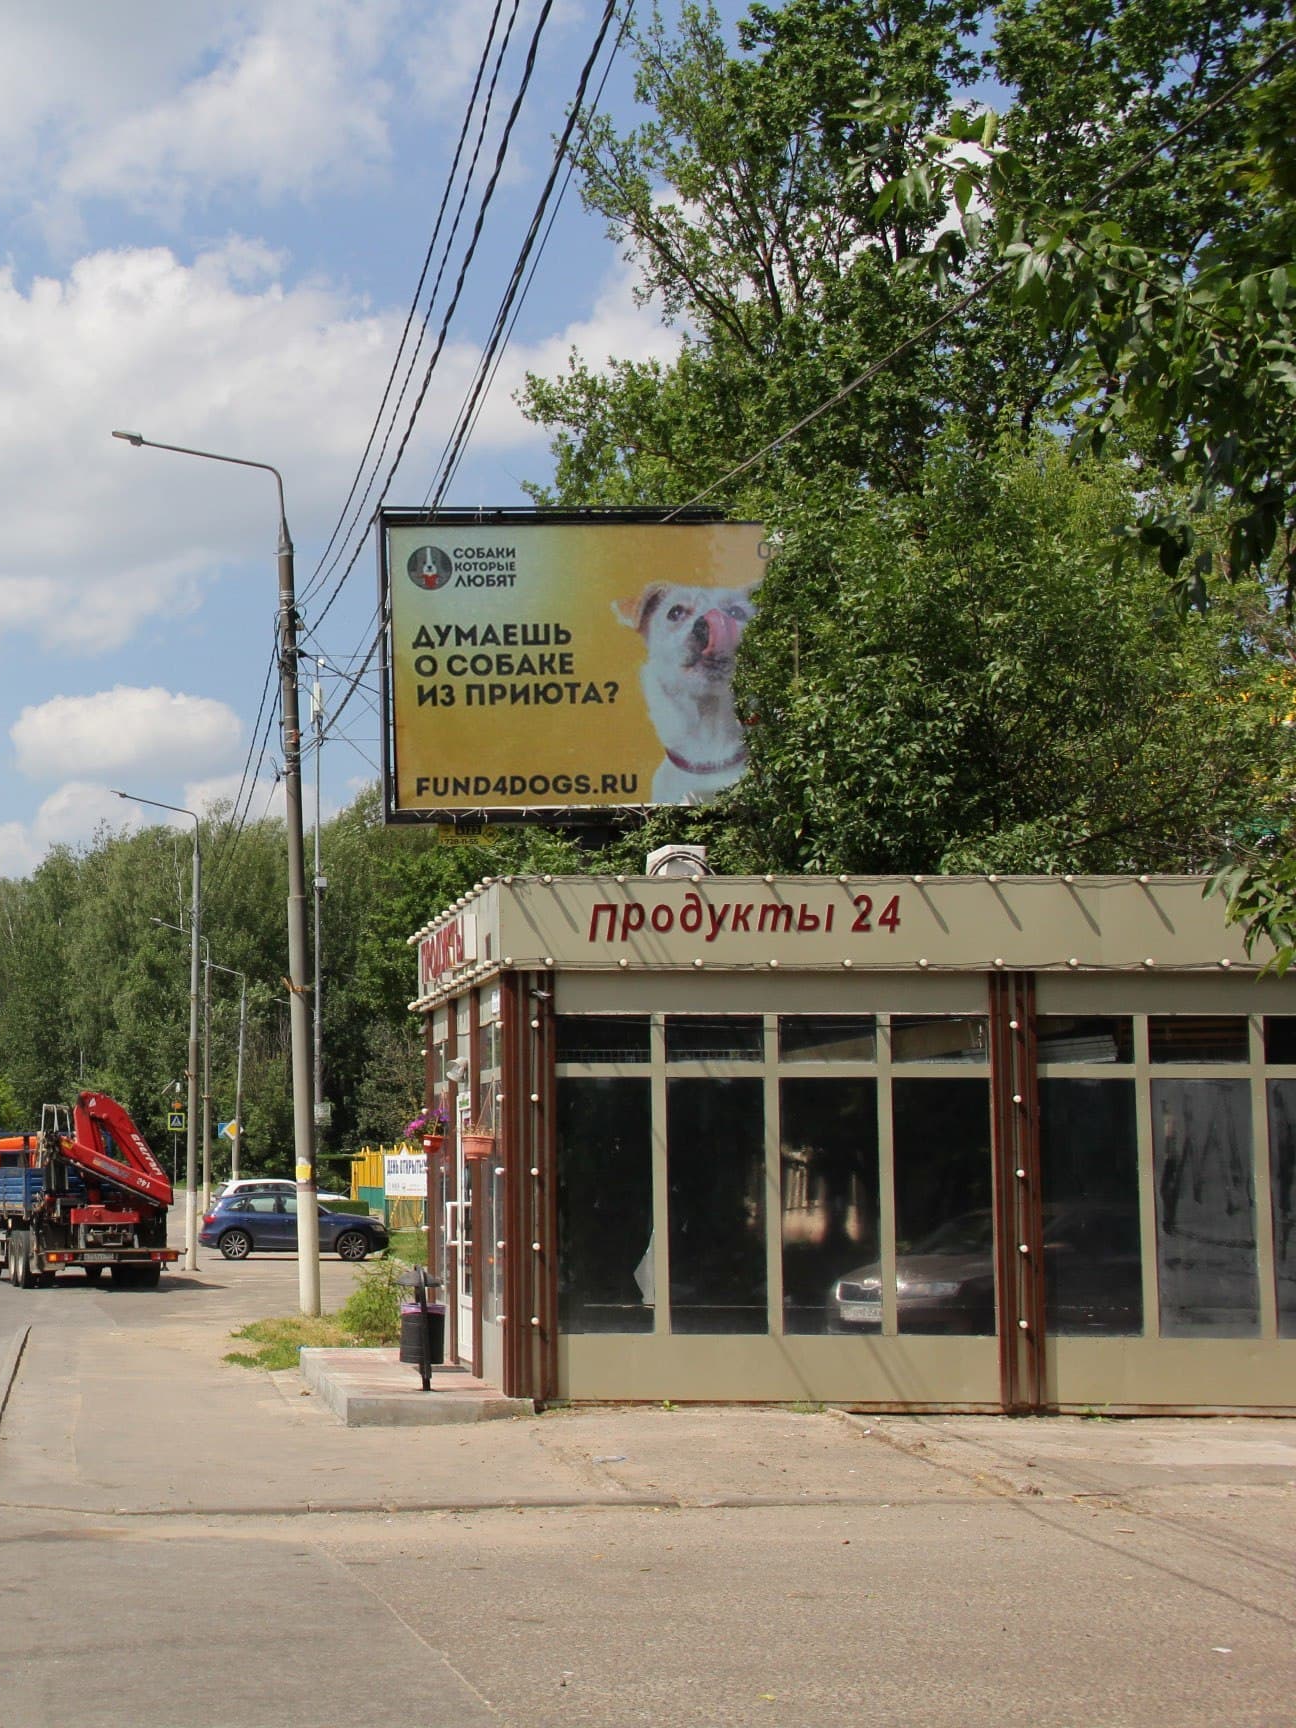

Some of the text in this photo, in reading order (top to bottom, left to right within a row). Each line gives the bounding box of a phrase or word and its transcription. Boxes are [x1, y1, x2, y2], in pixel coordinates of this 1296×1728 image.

[453, 547, 516, 559] СОБАКИ
[454, 561, 516, 571] КОТОРЫЕ
[455, 574, 517, 587] ЛЮБЯТ
[412, 623, 572, 650] ДУМАЕШЬ
[414, 652, 574, 677] О СОБАКЕ
[417, 681, 620, 707] ИЗ ПРИЮТА?
[416, 774, 638, 797] FUND4DOGS.RU
[851, 894, 901, 934] 24
